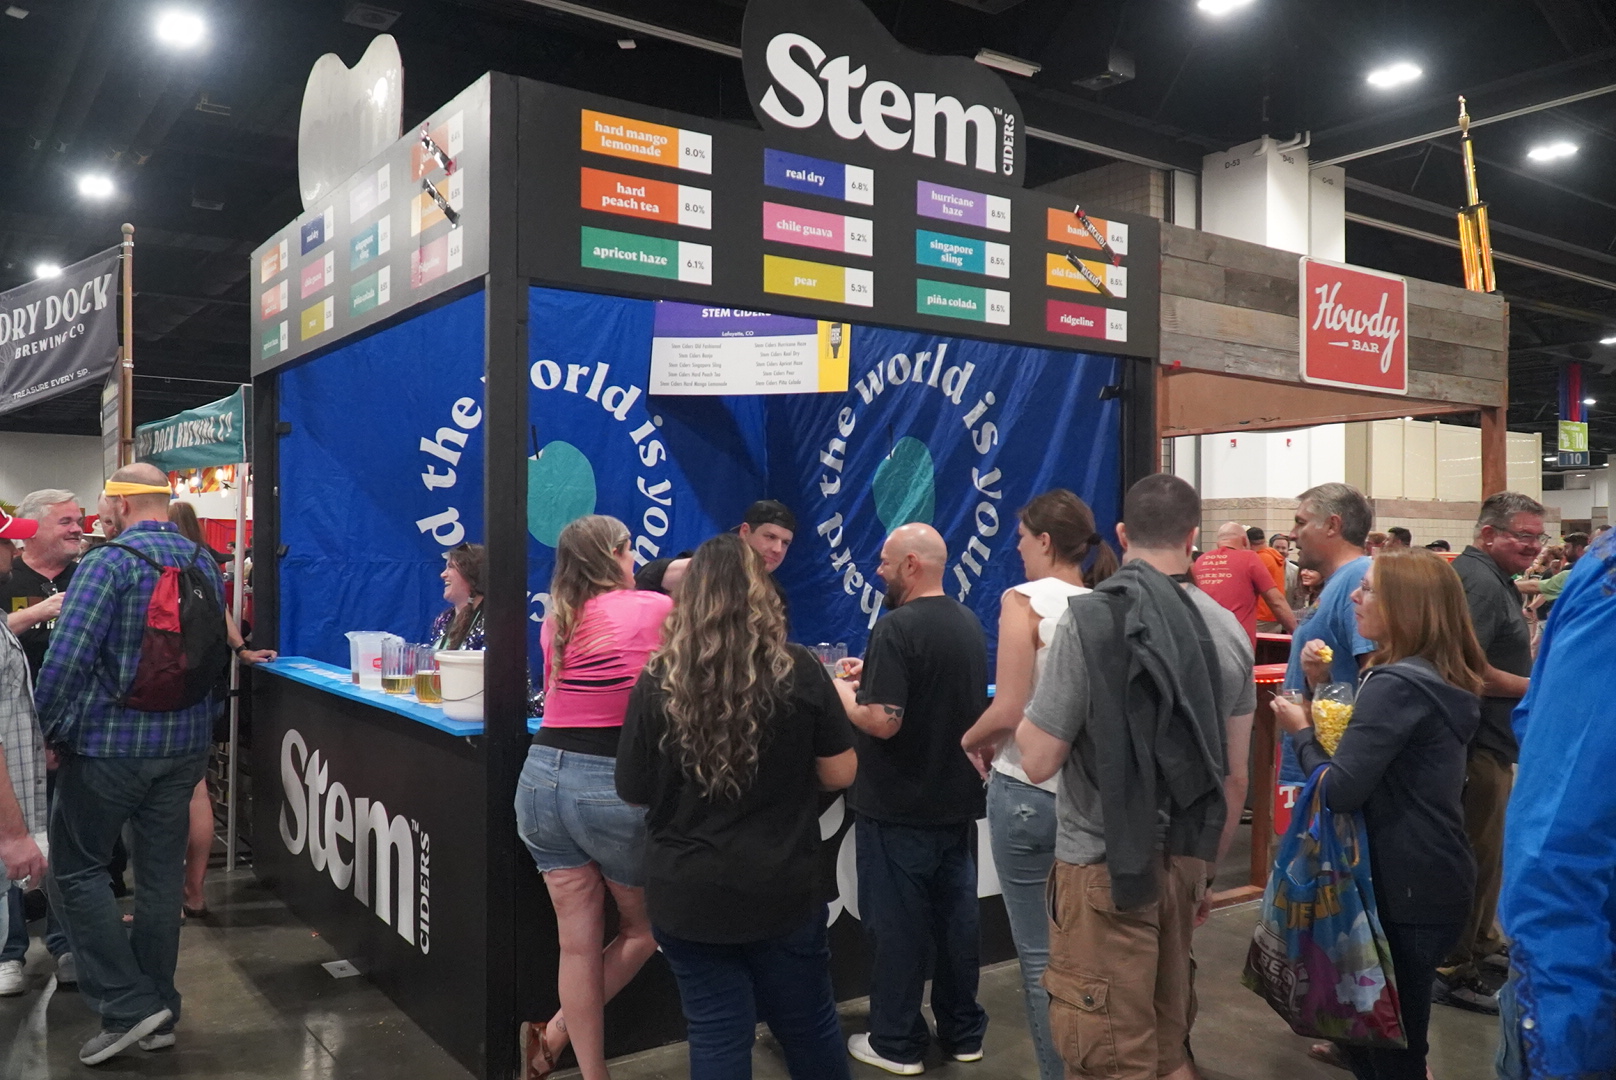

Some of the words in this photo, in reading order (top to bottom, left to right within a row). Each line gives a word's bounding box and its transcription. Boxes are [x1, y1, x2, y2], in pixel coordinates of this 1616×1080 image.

[760, 33, 996, 173] Stem
[595, 121, 623, 136] hard
[626, 128, 668, 146] mango
[601, 136, 661, 157] lemonade
[685, 147, 705, 159] 8.0%
[1003, 113, 1015, 176] CIDERS
[785, 169, 806, 181] real
[807, 172, 825, 186] dry
[616, 182, 645, 197] hard
[851, 181, 869, 192] 6.8%
[601, 195, 638, 210] peach
[641, 201, 660, 213] tea
[931, 191, 974, 208] hurricane
[685, 203, 705, 214] 8.0%
[942, 204, 963, 217] haze
[991, 209, 1006, 220] 8.5%
[776, 220, 801, 232] chile
[803, 224, 833, 238] guava
[850, 232, 867, 243] 5.2%
[1067, 225, 1089, 237] banjo
[593, 245, 637, 261] apricot
[640, 251, 668, 265] haze
[930, 239, 974, 255] singapore
[687, 259, 704, 270] 6.1%
[941, 253, 963, 267] sling
[990, 256, 1005, 266] 8.5%
[794, 275, 817, 287] pear
[851, 284, 868, 294] 5.3%
[0, 300, 41, 346] DRY
[44, 273, 112, 330] DOCK
[927, 294, 947, 307] piña
[948, 297, 977, 310] colada
[990, 303, 1005, 313] 8.5%
[702, 308, 731, 318] STEM
[1060, 314, 1094, 327] ridgeline
[1312, 281, 1400, 373] Howdy
[14, 332, 67, 359] BREWING
[1352, 340, 1380, 354] BAR
[12, 382, 49, 400] TREASURE
[51, 372, 75, 388] EVERY
[480, 359, 642, 422] orld
[855, 343, 976, 405] world
[962, 391, 998, 455] is
[152, 425, 175, 454] DOCK
[419, 396, 483, 492] the
[629, 414, 667, 467] is
[820, 406, 857, 499] the
[1570, 453, 1582, 465] 10
[631, 476, 673, 567] you
[817, 512, 885, 630] hard
[279, 729, 415, 946] Stem
[420, 831, 430, 955] CIDERS
